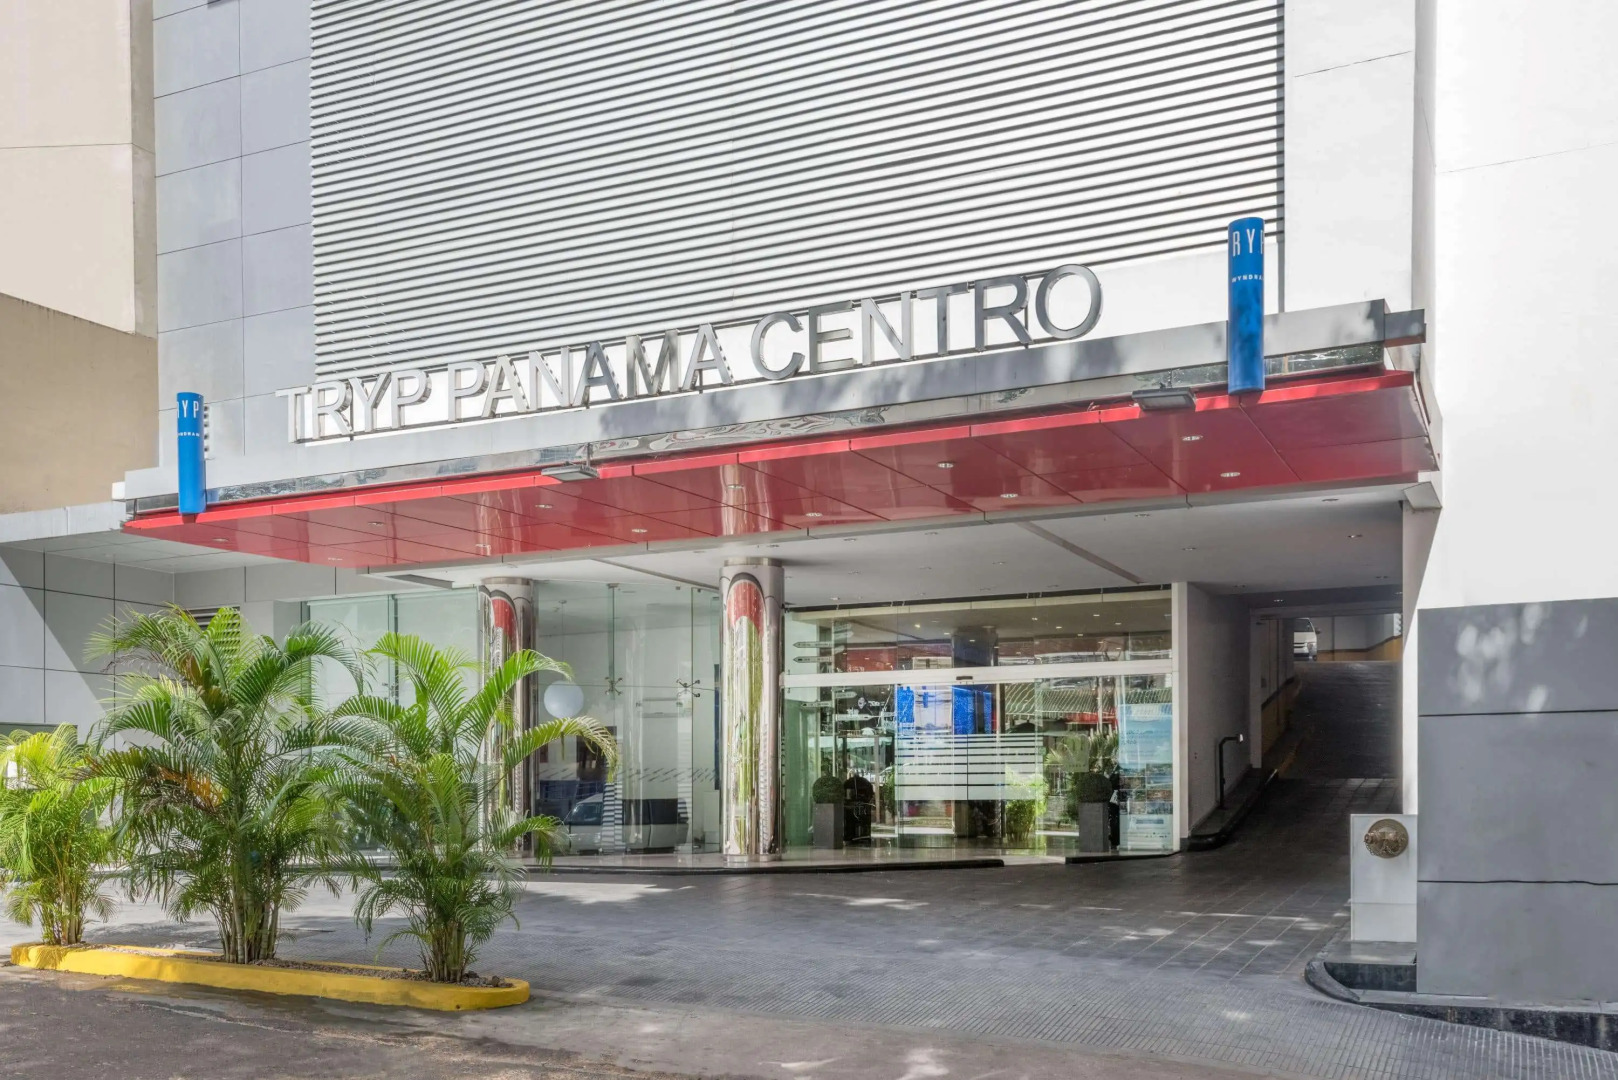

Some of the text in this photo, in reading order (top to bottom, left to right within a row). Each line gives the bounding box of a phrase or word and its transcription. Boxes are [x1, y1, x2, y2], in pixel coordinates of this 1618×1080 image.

[276, 264, 1102, 443] TRYP PANAMA CENTRO
